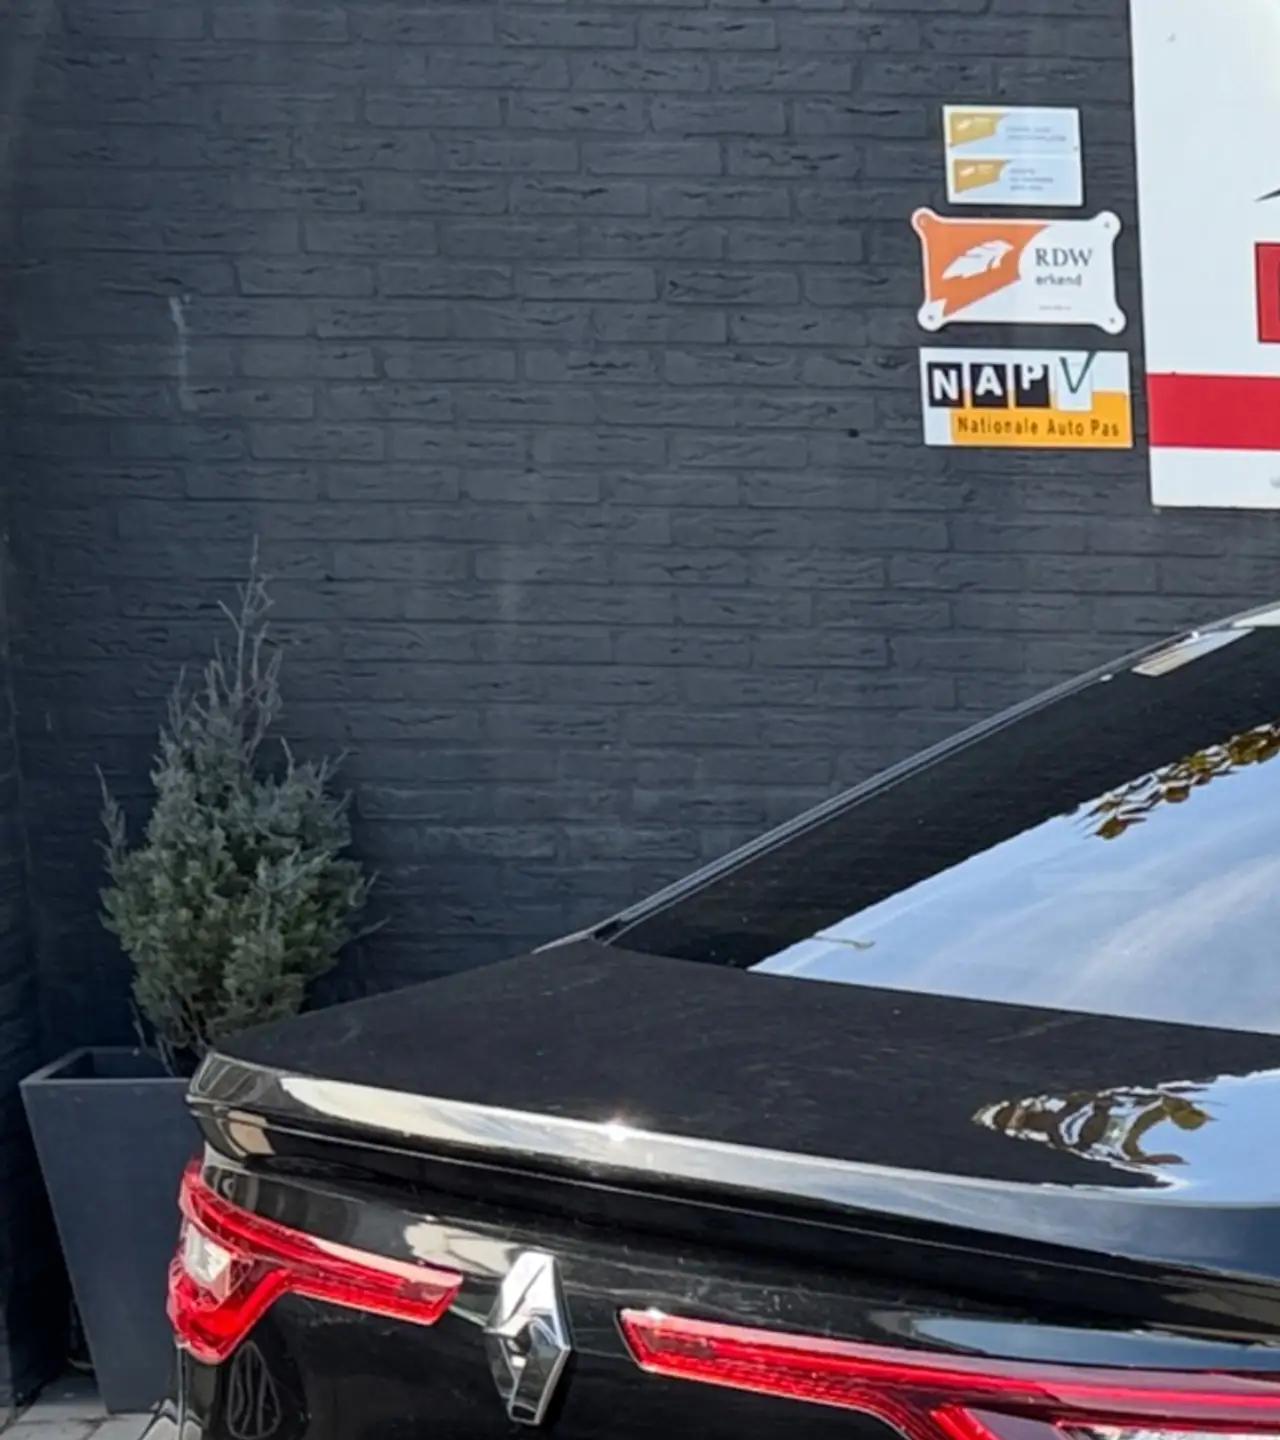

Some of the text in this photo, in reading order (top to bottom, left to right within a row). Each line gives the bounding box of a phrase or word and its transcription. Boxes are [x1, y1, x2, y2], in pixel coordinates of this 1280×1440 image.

[1035, 247, 1094, 267] RDW
[1035, 272, 1082, 288] erkend
[957, 416, 1120, 437] Nationale Auto Pas
